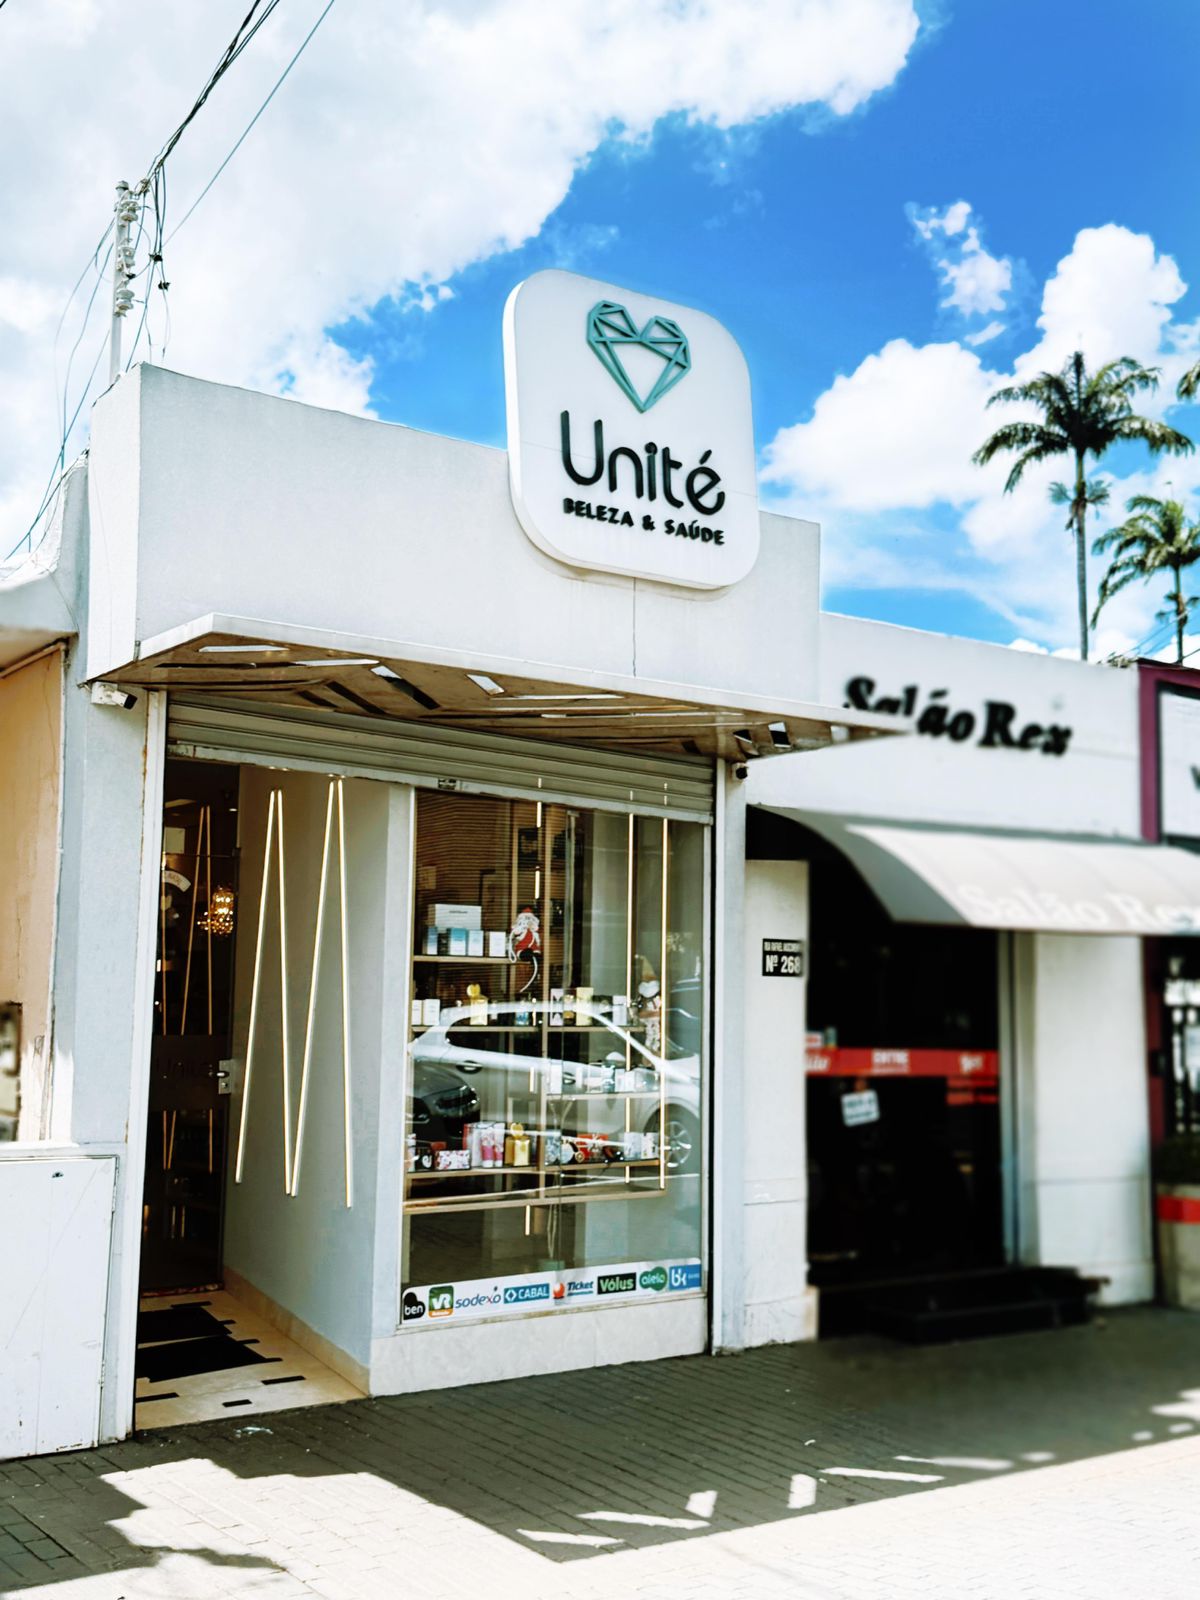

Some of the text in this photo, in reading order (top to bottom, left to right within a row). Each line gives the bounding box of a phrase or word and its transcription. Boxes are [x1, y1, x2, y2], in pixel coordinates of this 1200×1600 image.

[560, 410, 726, 516] Unité
[562, 497, 726, 546] BELEZA & SAÚDE
[567, 1280, 594, 1291] Ticket
[518, 1287, 549, 1300] CABAL
[455, 1293, 502, 1309] sodexo
[404, 1304, 424, 1316] ben
